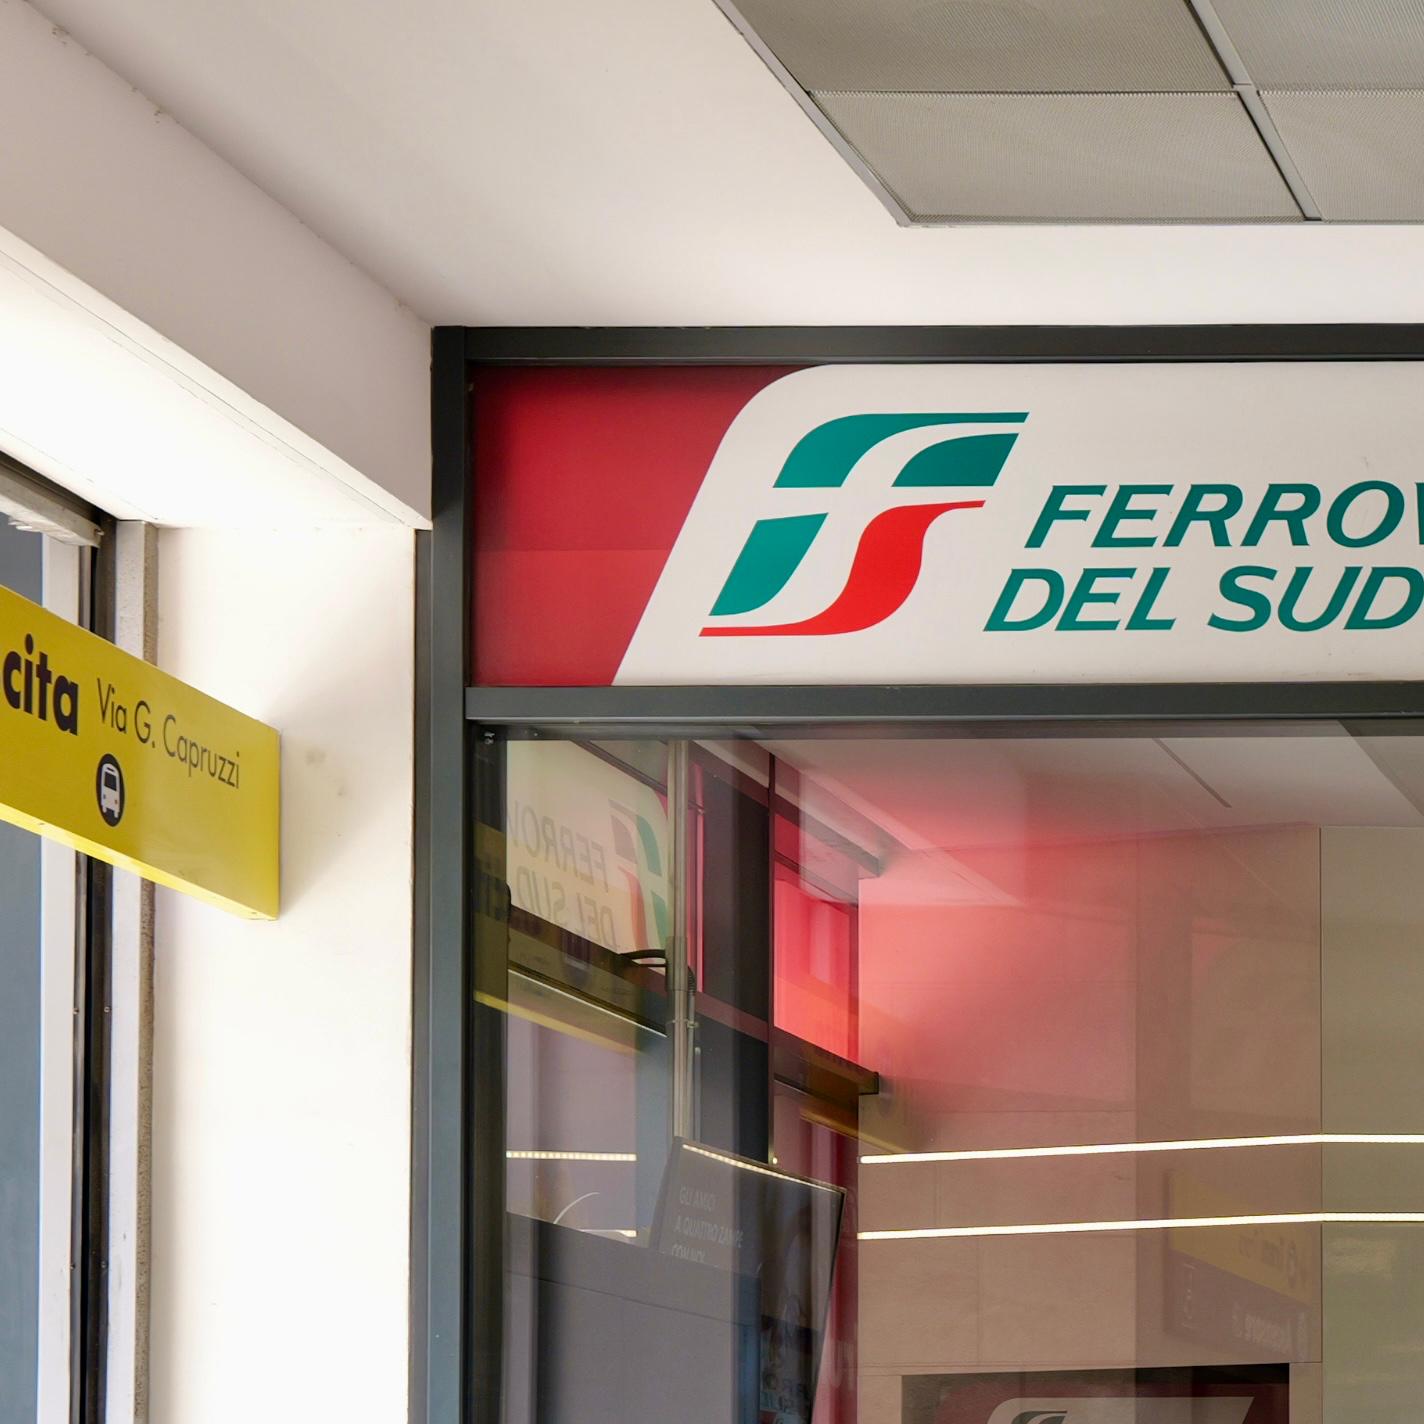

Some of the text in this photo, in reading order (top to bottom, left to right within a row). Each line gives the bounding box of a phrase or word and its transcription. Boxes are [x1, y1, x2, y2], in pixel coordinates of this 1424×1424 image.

[983, 566, 1181, 632] DEL
[1207, 565, 1424, 633] SUD
[2, 633, 80, 737] cita
[96, 677, 241, 790] Via G. Capruzzi
